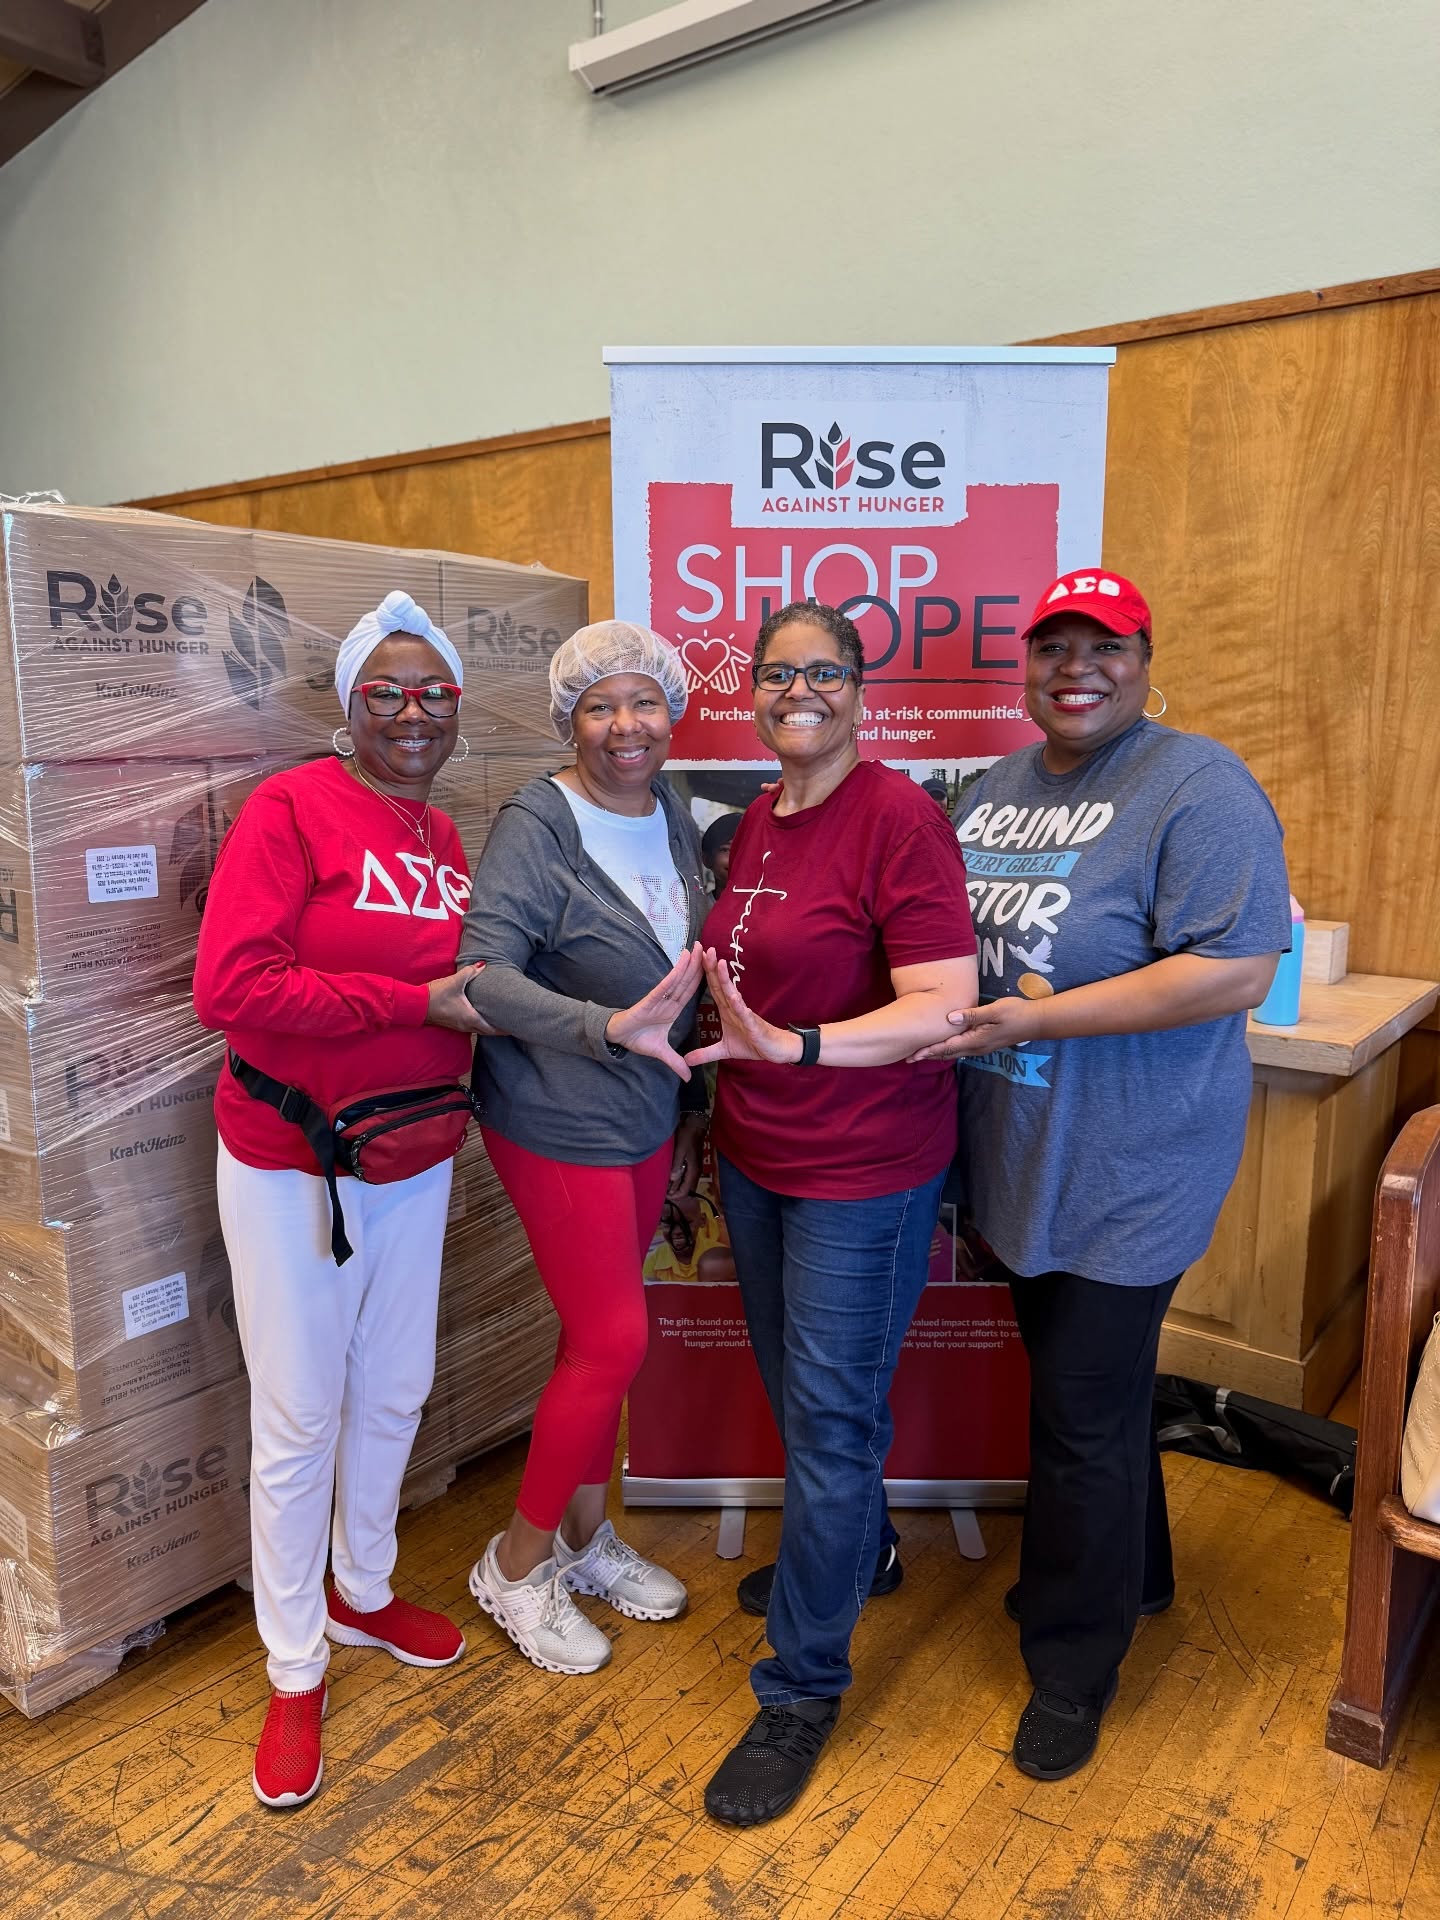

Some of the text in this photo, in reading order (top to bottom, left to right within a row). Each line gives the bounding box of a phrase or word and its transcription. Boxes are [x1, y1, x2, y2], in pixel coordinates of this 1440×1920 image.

[761, 421, 946, 490] Rise
[761, 496, 945, 513] AGAINST HUNGER
[676, 543, 938, 623] SHOP
[46, 570, 208, 636] Rise
[761, 595, 1020, 672] OPE
[52, 635, 210, 656] AGAINST HUNGER
[700, 707, 756, 721] Purchas
[875, 706, 924, 721] at-risk
[926, 705, 1024, 721] communities
[882, 728, 936, 743] hunger.
[1006, 854, 1066, 874] GREAT
[353, 848, 474, 920] ΔΣΘ
[150, 1085, 215, 1110] HUNGER
[658, 1317, 675, 1326] The
[676, 1317, 695, 1328] gifts
[696, 1317, 721, 1326] found
[911, 1318, 940, 1327] valued
[941, 1318, 970, 1329] impact
[972, 1318, 996, 1327] made
[661, 1330, 682, 1338] your
[682, 1328, 727, 1338] generosity
[728, 1328, 741, 1337] for
[919, 1330, 952, 1339] support
[953, 1330, 969, 1338] our
[969, 1328, 999, 1338] efforts
[1000, 1329, 1010, 1338] to
[684, 1339, 714, 1349] hunger
[715, 1338, 746, 1348] around
[915, 1341, 932, 1350] you
[933, 1340, 945, 1349] for
[946, 1341, 967, 1350] your
[967, 1340, 1004, 1350] support!
[85, 1445, 229, 1531] Rise
[90, 1478, 230, 1549] AGAINST HUNGER
